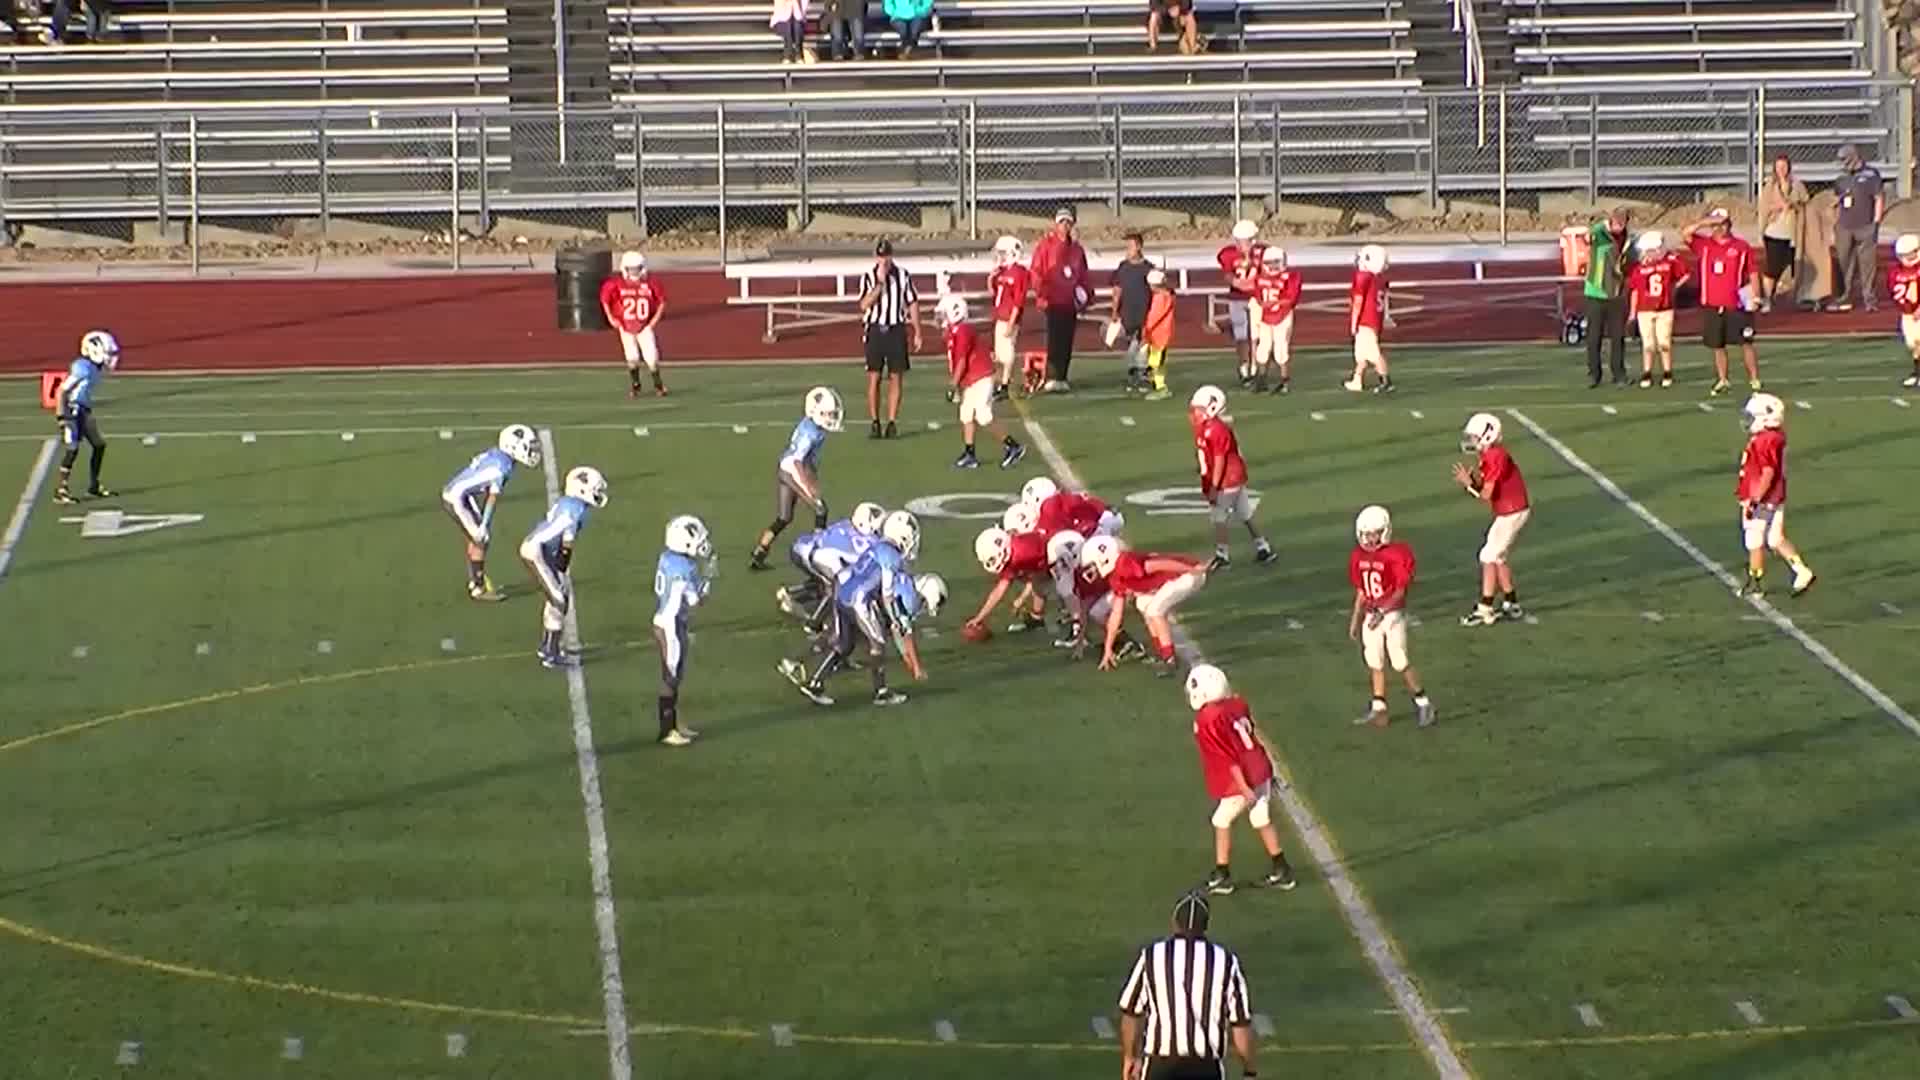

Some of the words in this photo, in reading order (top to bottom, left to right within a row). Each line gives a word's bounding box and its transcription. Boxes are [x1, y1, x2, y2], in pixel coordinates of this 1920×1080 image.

[1649, 273, 1663, 297] 6
[623, 297, 650, 321] 20
[1362, 570, 1385, 599] 16
